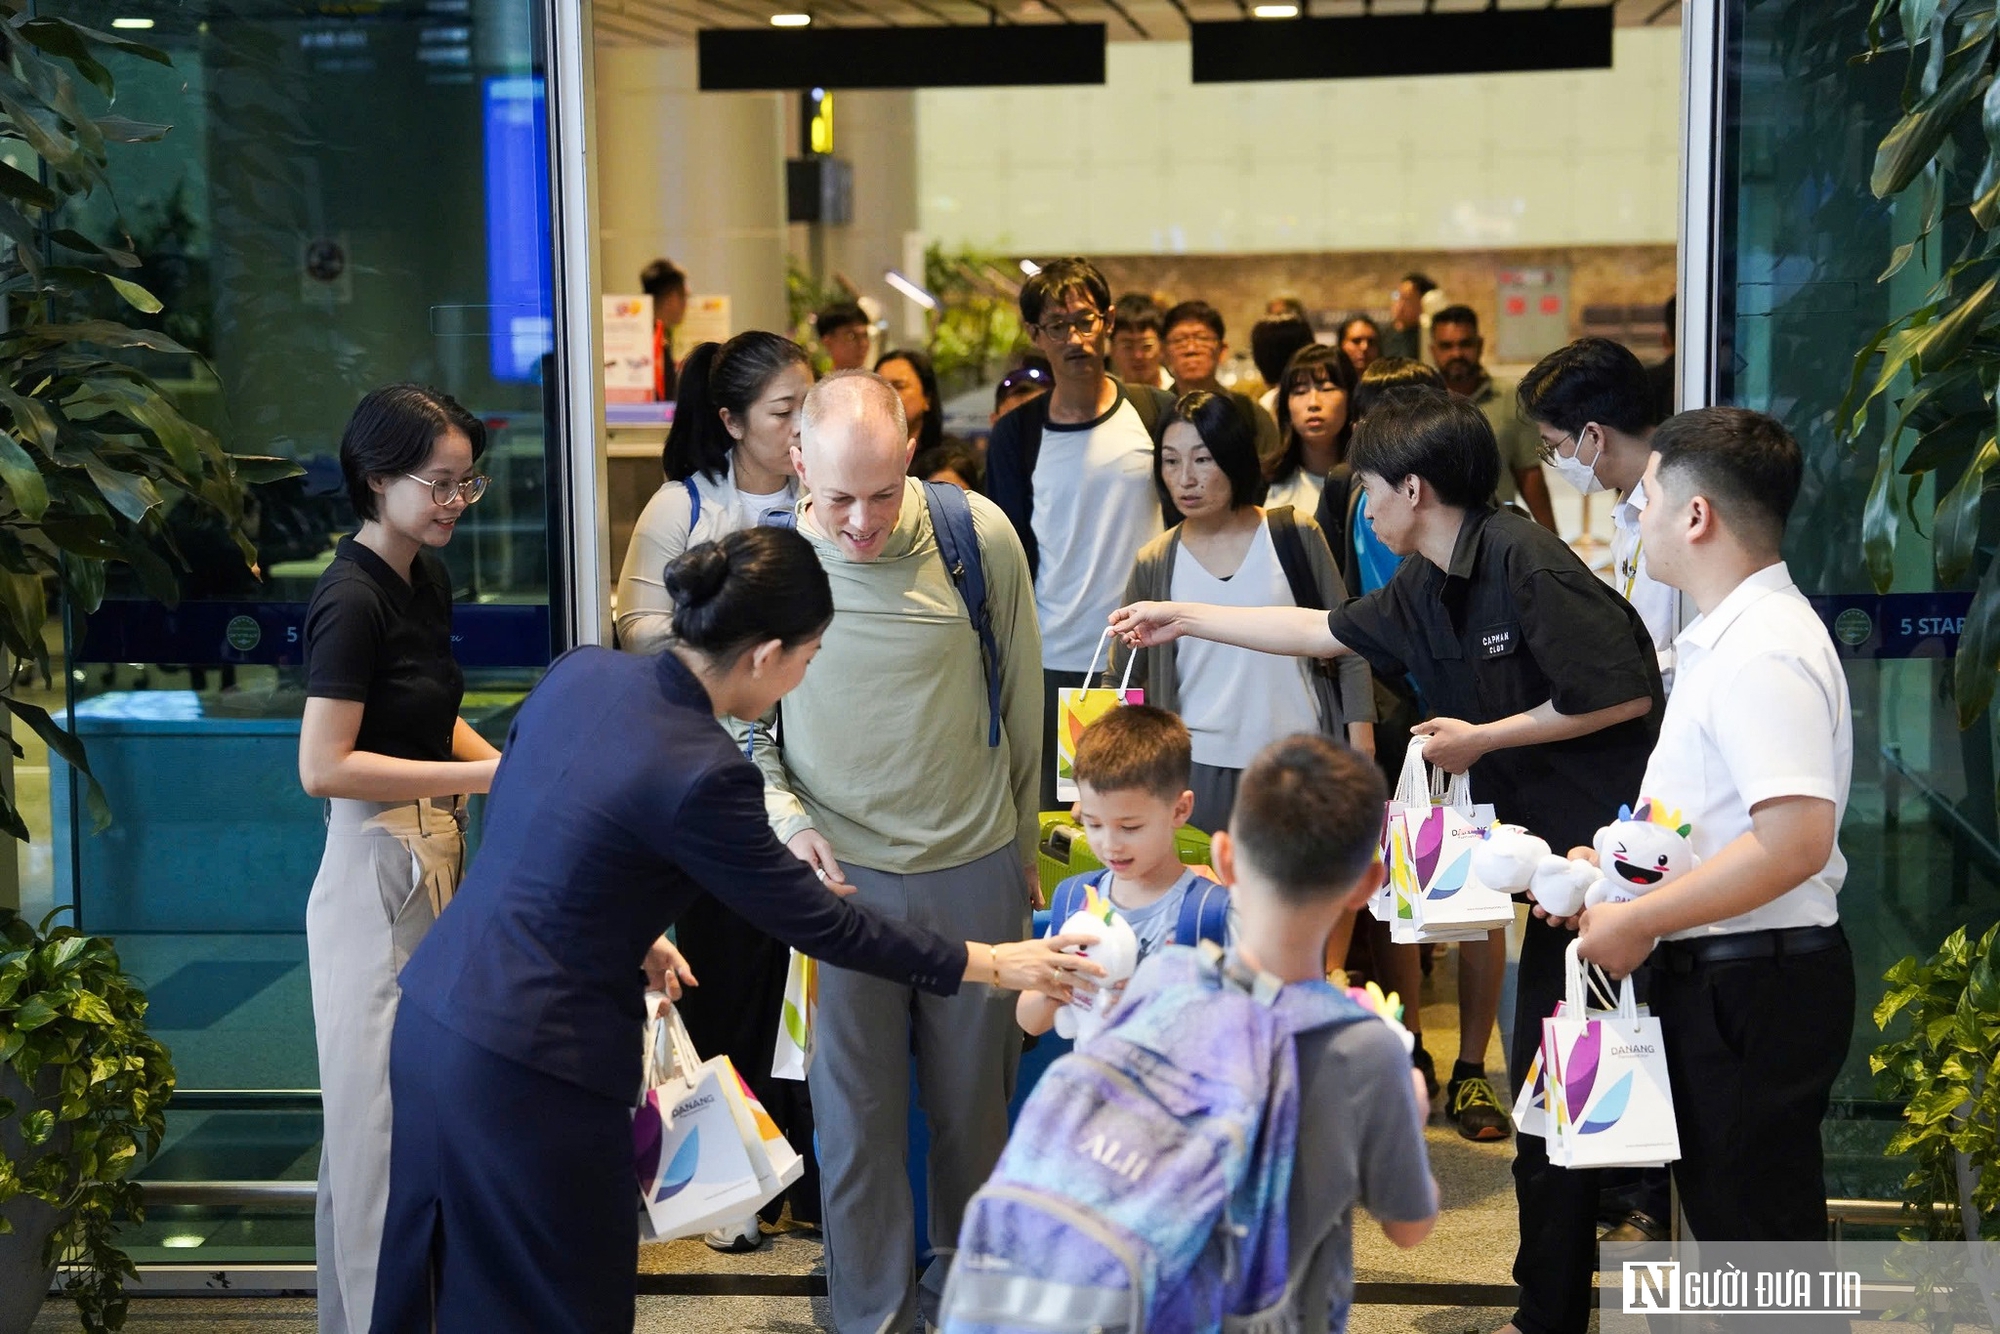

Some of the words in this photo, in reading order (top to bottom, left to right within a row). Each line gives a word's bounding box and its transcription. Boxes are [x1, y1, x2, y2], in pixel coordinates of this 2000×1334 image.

[287, 626, 298, 643] 5
[1901, 618, 1913, 636] 5
[1611, 1045, 1655, 1055] DANANG
[671, 1094, 715, 1118] DANANG
